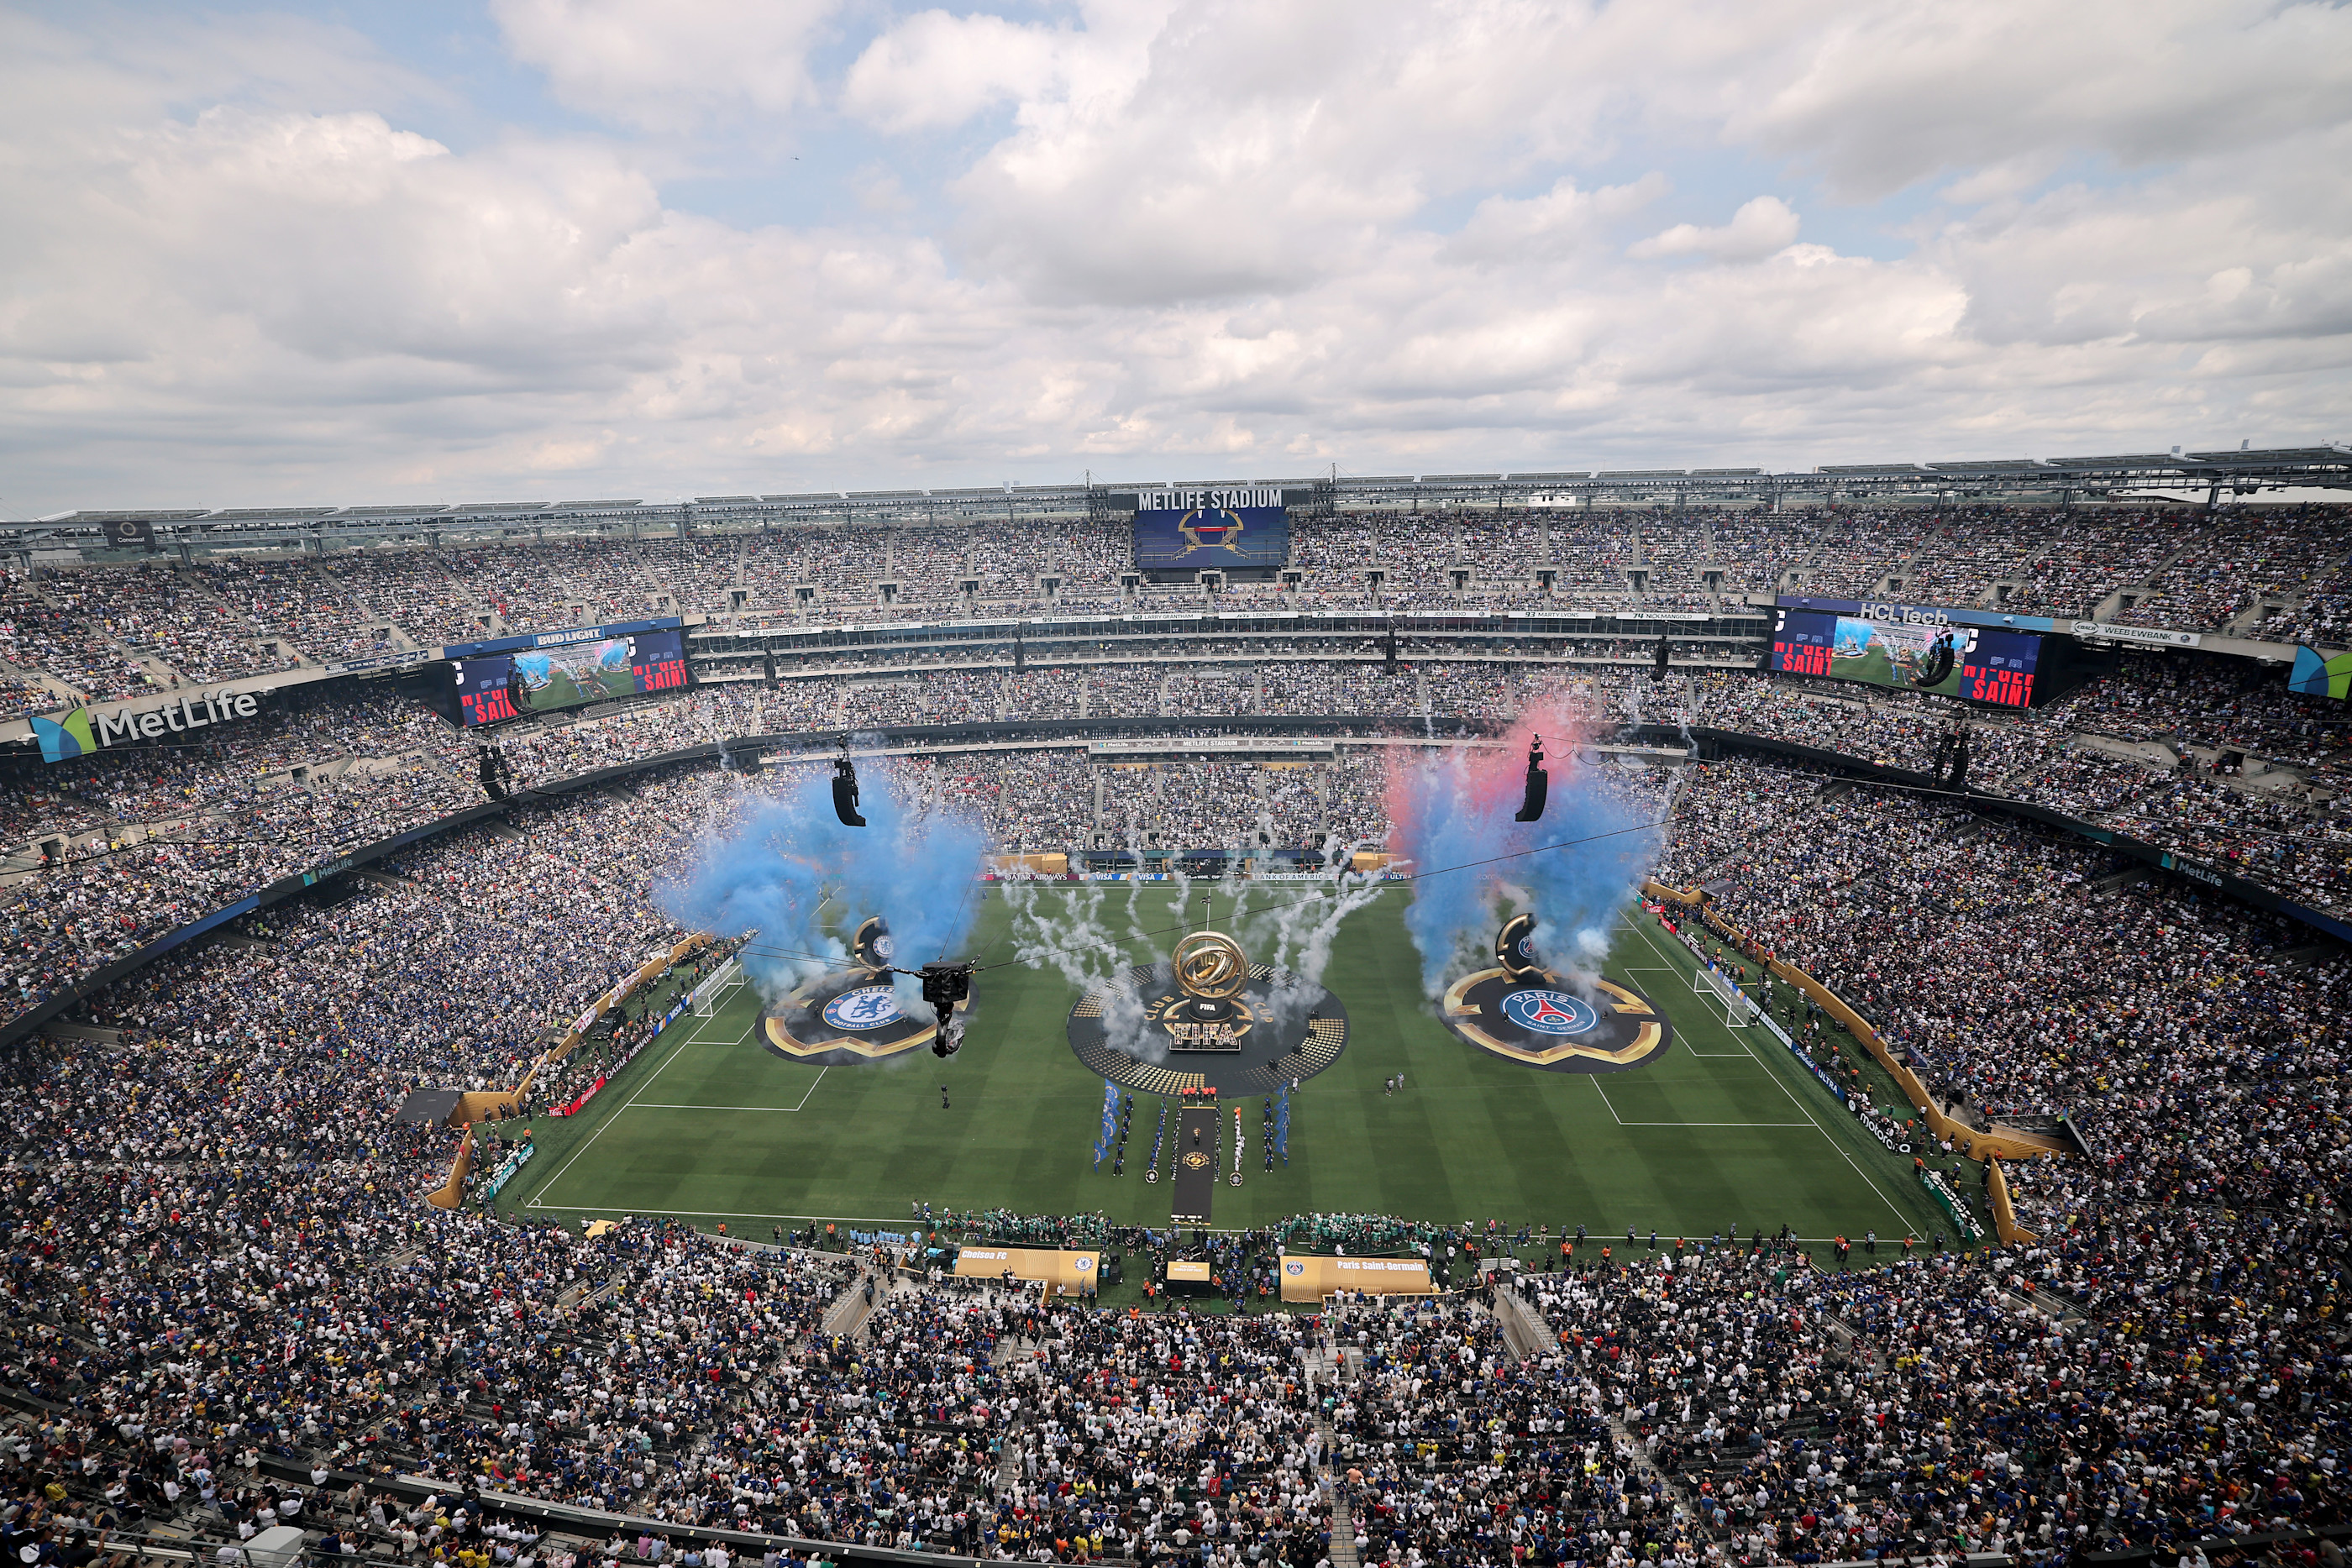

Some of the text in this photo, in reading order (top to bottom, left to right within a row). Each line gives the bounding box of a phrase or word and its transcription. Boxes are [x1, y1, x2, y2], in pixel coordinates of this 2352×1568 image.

[1138, 490, 1283, 511] METLIFE STADIUM
[1860, 602, 1949, 625] HCLTech
[537, 628, 602, 647] BUD LIGHT
[2104, 627, 2130, 637] WEEB
[2131, 630, 2172, 641] EWBANK
[96, 688, 258, 747] MetLife
[318, 858, 353, 878] MetLife
[2178, 861, 2223, 887] MetLife
[1199, 1003, 1216, 1011] FIFA
[1512, 992, 1569, 1003] PARIS
[669, 1003, 683, 1020] VISA
[1143, 994, 1174, 1021] CLUB
[1253, 1002, 1274, 1023] CUP
[830, 1017, 890, 1028] FOOTBALL CLUB
[1525, 1020, 1551, 1030] SAINT
[1764, 1017, 1786, 1041] AMERICA
[1173, 1022, 1238, 1046] FIFA
[605, 1032, 654, 1081] QATAR AIRWAYS
[1818, 1069, 1839, 1094] ULTRA
[1924, 1176, 1935, 1190] PIF
[962, 1250, 995, 1259] Chelsea
[1337, 1261, 1424, 1271] Paris Saint-Germain
